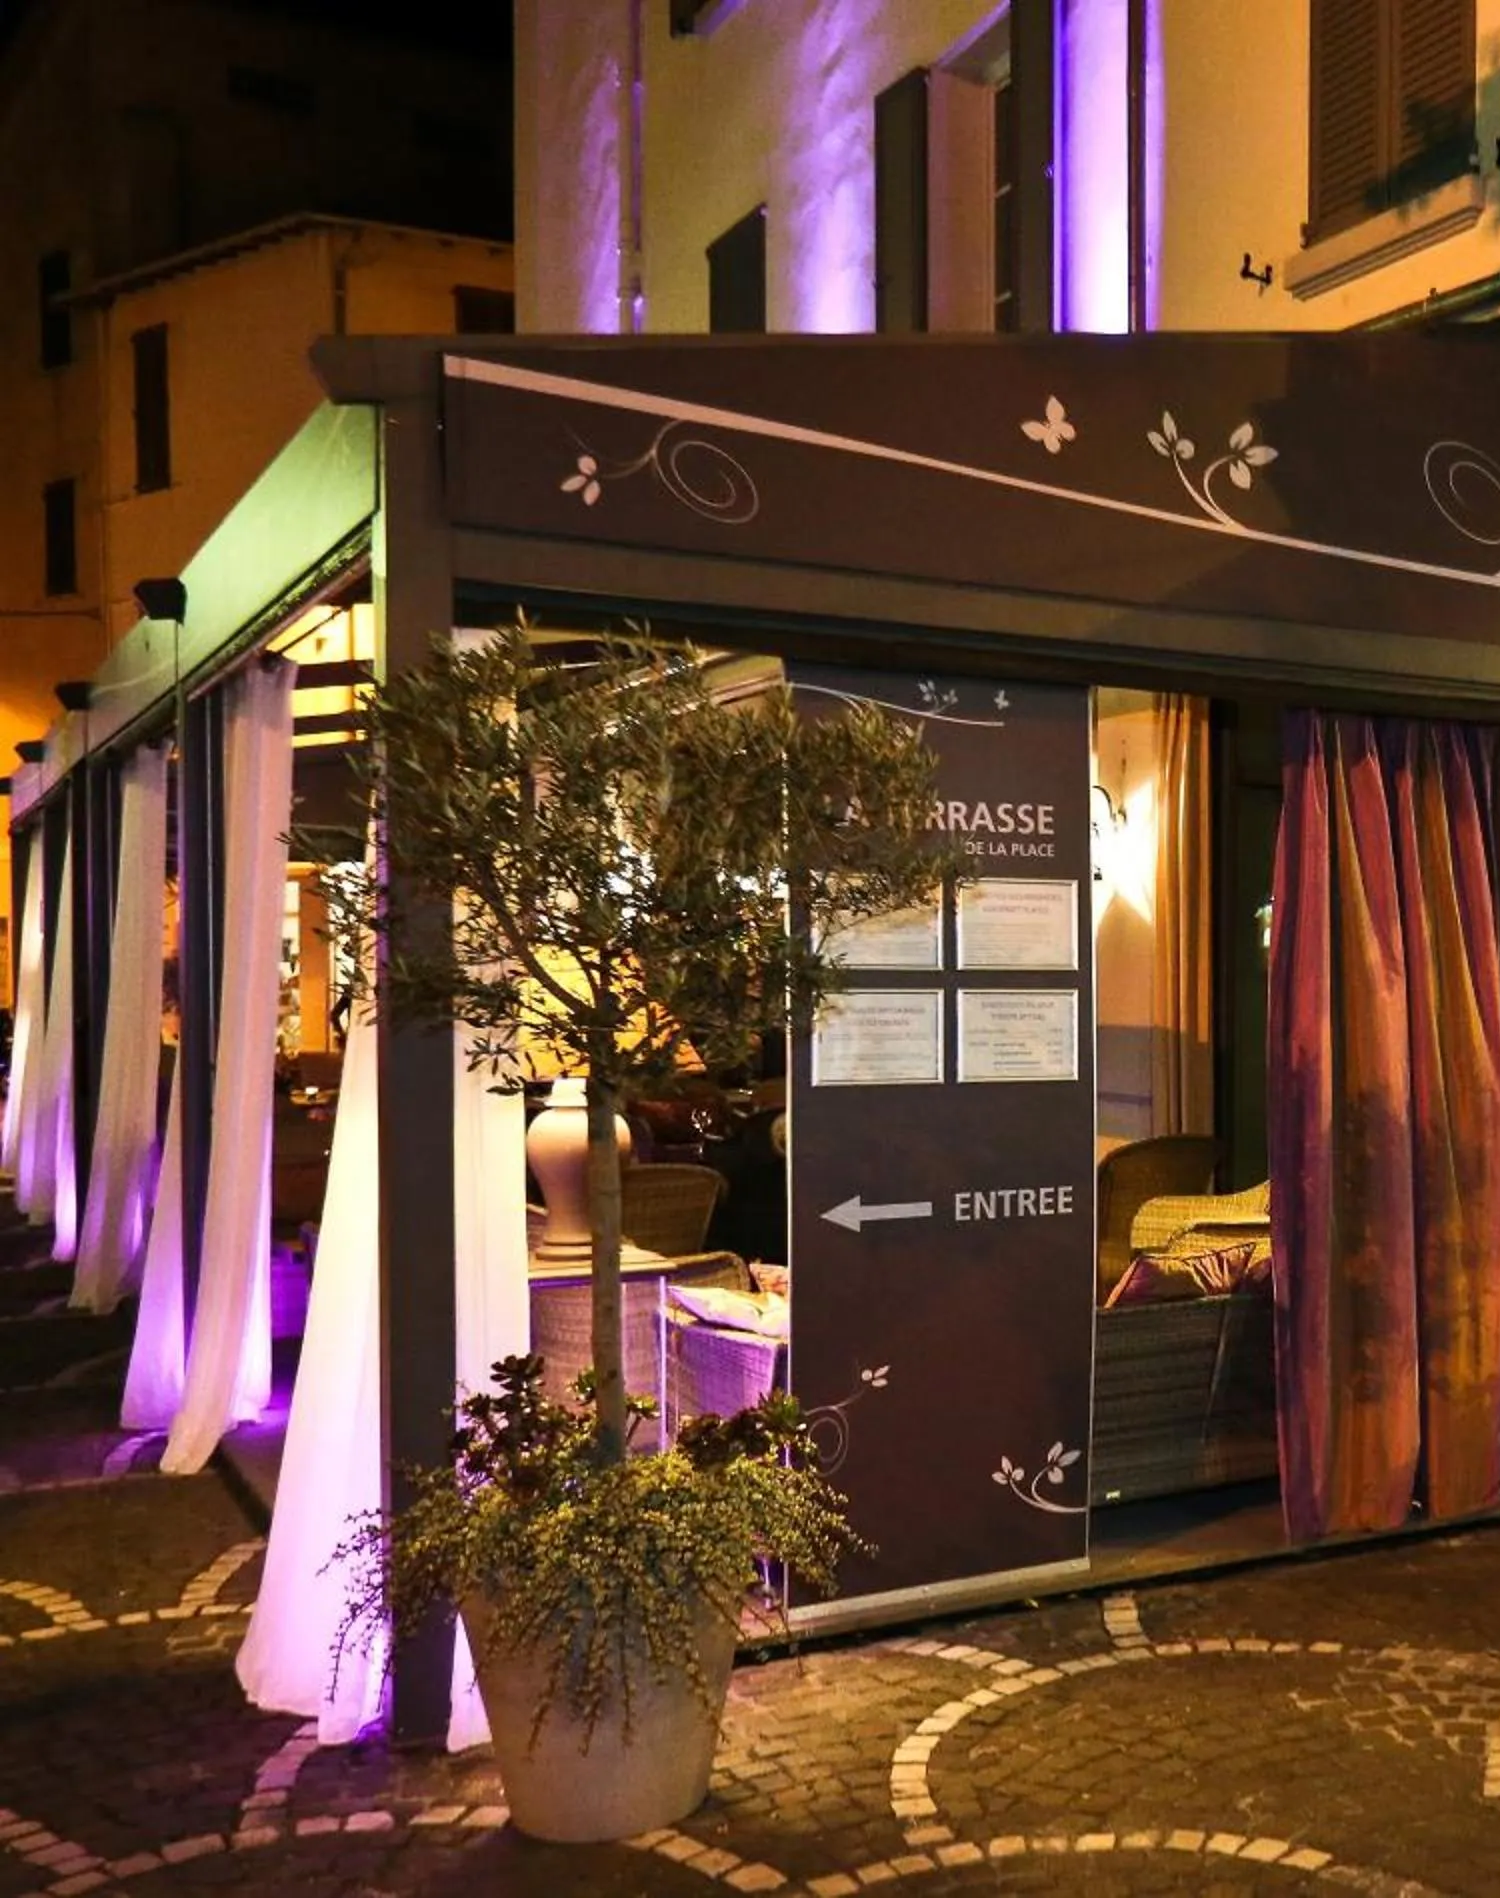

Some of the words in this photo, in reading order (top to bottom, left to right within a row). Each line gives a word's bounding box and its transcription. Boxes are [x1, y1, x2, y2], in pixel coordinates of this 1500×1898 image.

[886, 797, 1056, 836] RRASSE
[965, 841, 985, 855] DE
[988, 841, 1008, 857] LA
[1011, 842, 1055, 858] PLACE
[954, 1185, 1074, 1222] ENTREE
